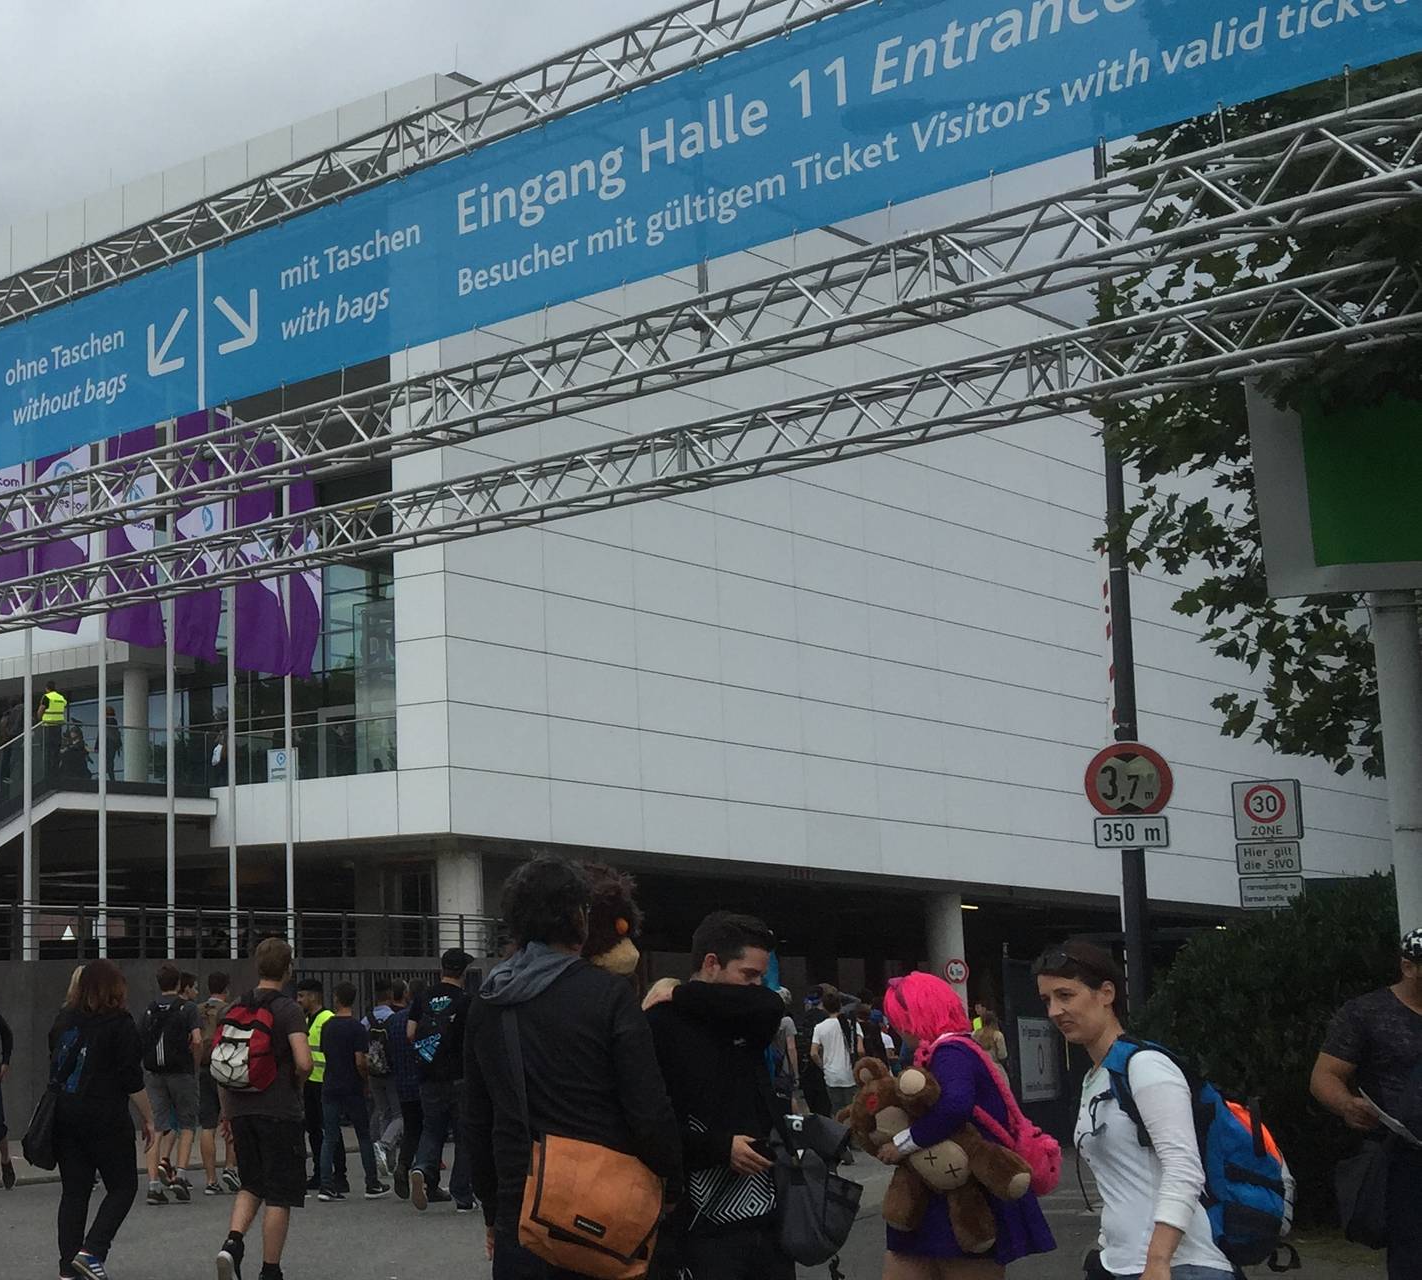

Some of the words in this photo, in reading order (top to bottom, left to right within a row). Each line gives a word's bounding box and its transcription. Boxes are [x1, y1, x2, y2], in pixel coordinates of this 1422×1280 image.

[457, 145, 627, 235] Eingang
[640, 93, 769, 174] Halle
[789, 55, 848, 119] 11
[871, 0, 1135, 95] Entranc
[457, 238, 579, 297] Besucher
[586, 214, 637, 257] mit
[646, 172, 785, 246] gültigem
[792, 130, 899, 190] Ticket
[912, 86, 1051, 153] Visitors
[1061, 48, 1150, 107] with
[1161, 6, 1267, 75] valid
[1276, 0, 1409, 39] tick
[280, 255, 320, 290] mit
[323, 224, 421, 274] Taschen
[281, 300, 329, 341] with
[335, 287, 390, 324] bags
[5, 357, 48, 386] ohne
[51, 330, 125, 370] Taschen
[12, 385, 81, 426] without
[84, 373, 127, 404] bags
[1100, 765, 1140, 803] 3,7
[1252, 795, 1277, 813] 30
[1102, 823, 1135, 842] 350
[1145, 826, 1161, 842] m
[1243, 848, 1268, 857] Hier
[1274, 847, 1292, 858] gilt
[1251, 825, 1283, 836] ZONE
[1244, 861, 1261, 870] die
[1267, 859, 1294, 869] StVO
